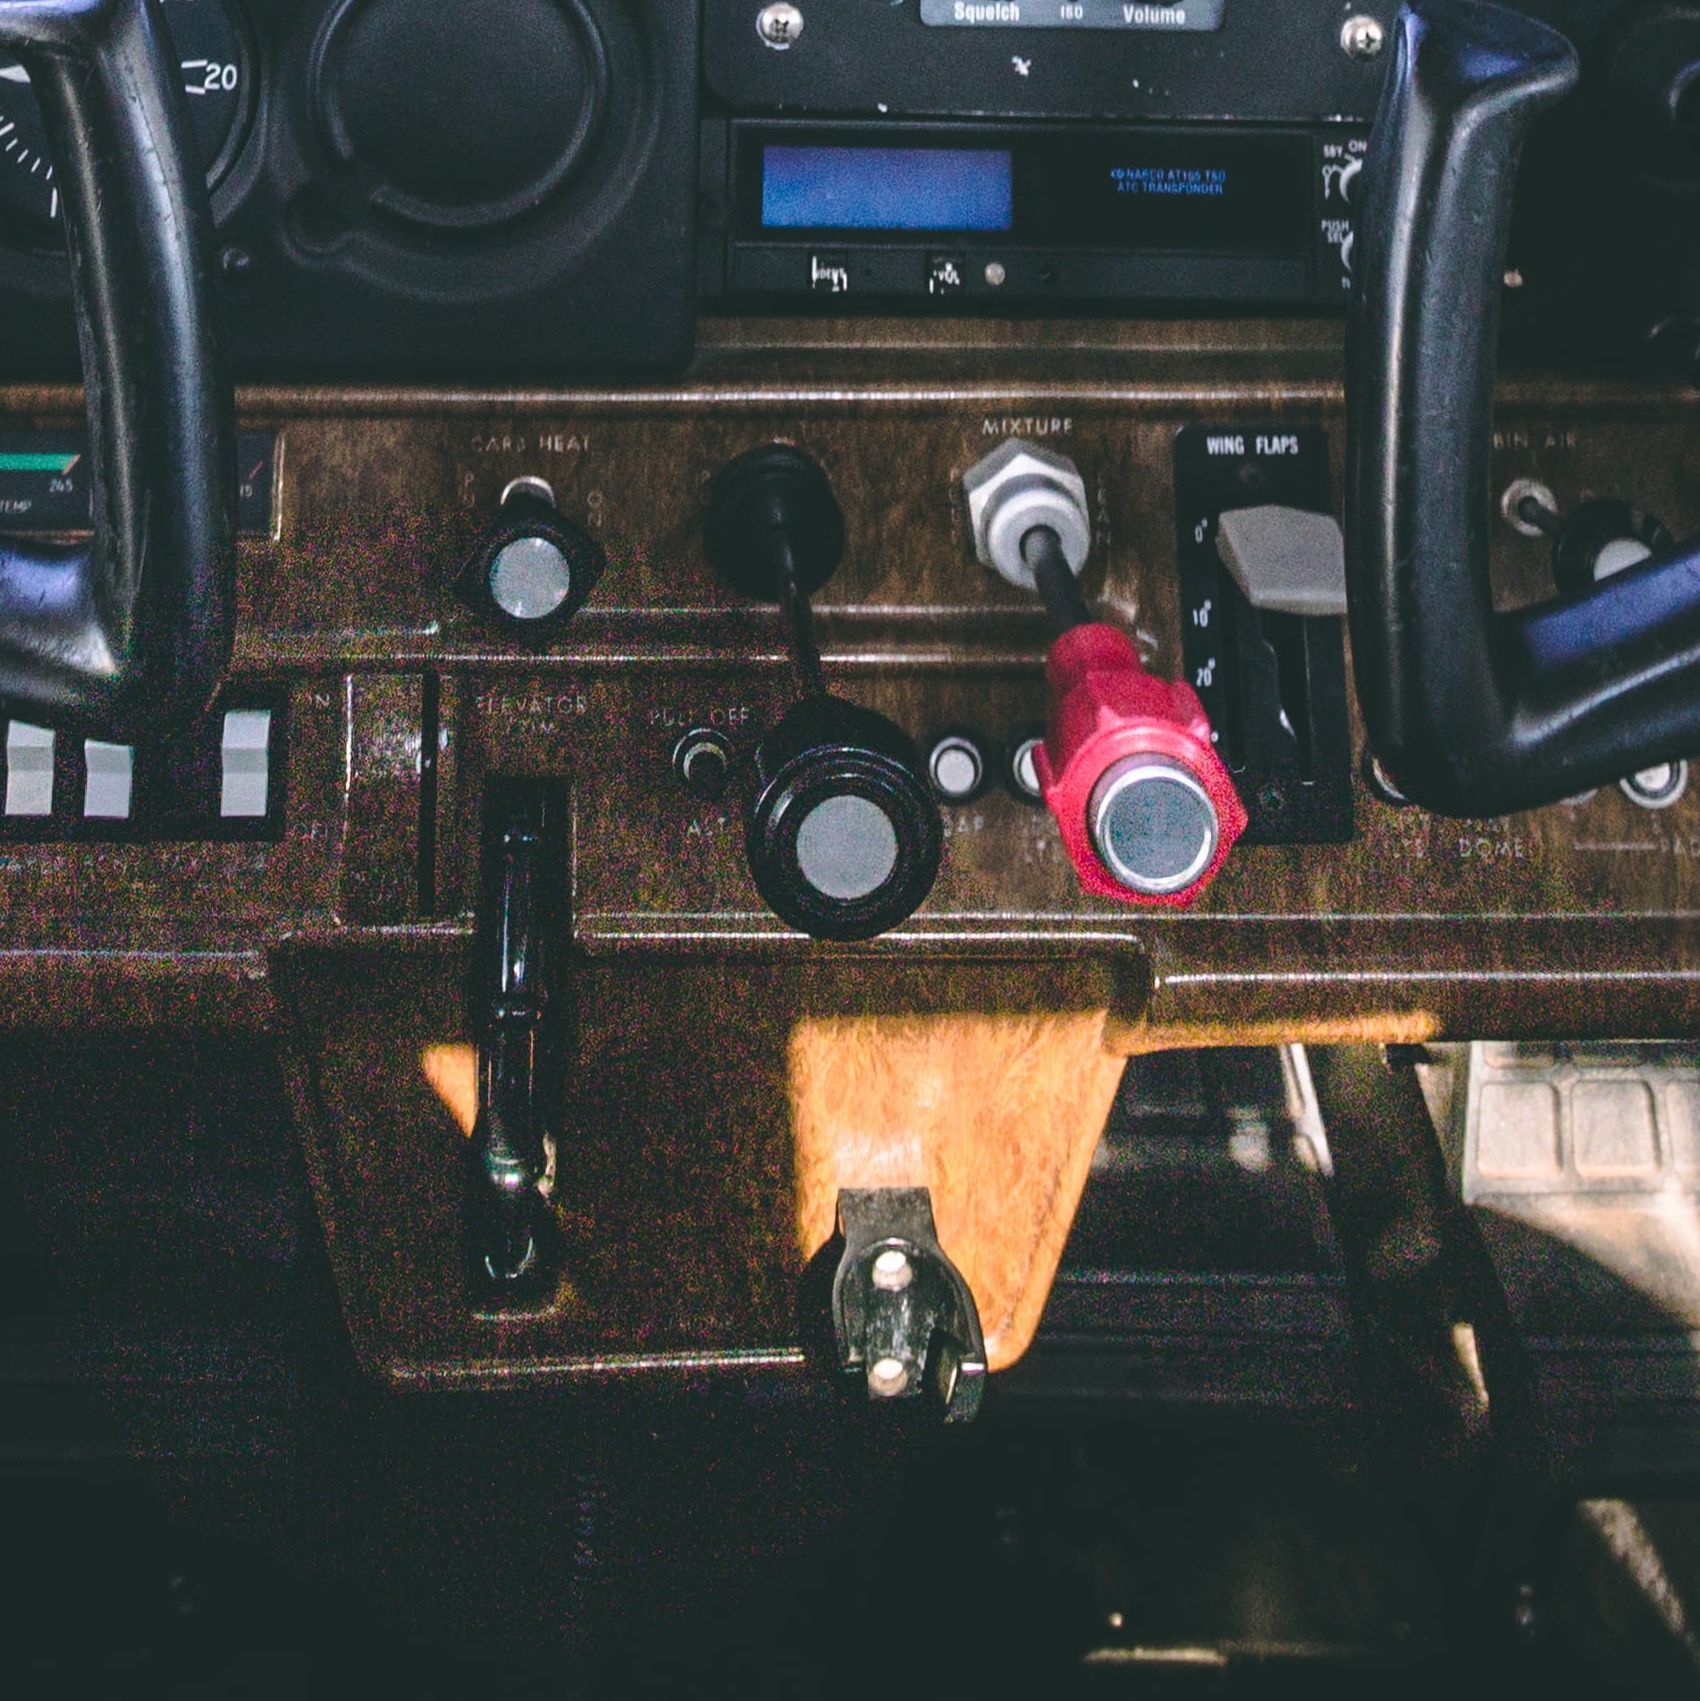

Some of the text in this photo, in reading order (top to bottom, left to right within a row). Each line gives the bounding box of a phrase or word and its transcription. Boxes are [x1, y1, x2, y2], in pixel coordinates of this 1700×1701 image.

[954, 2, 1020, 23] Squelch
[1060, 6, 1084, 20] ISO
[1123, 5, 1186, 25] Volume
[204, 63, 237, 91] 20
[1348, 140, 1368, 153] ON
[1117, 181, 1224, 195] ATC TRANSPONDER
[1321, 219, 1349, 232] PUSH
[982, 417, 1073, 436] MIXTURE
[1206, 436, 1299, 455] WING FLAPS
[50, 479, 73, 493] 245
[0, 500, 33, 514] TEMP
